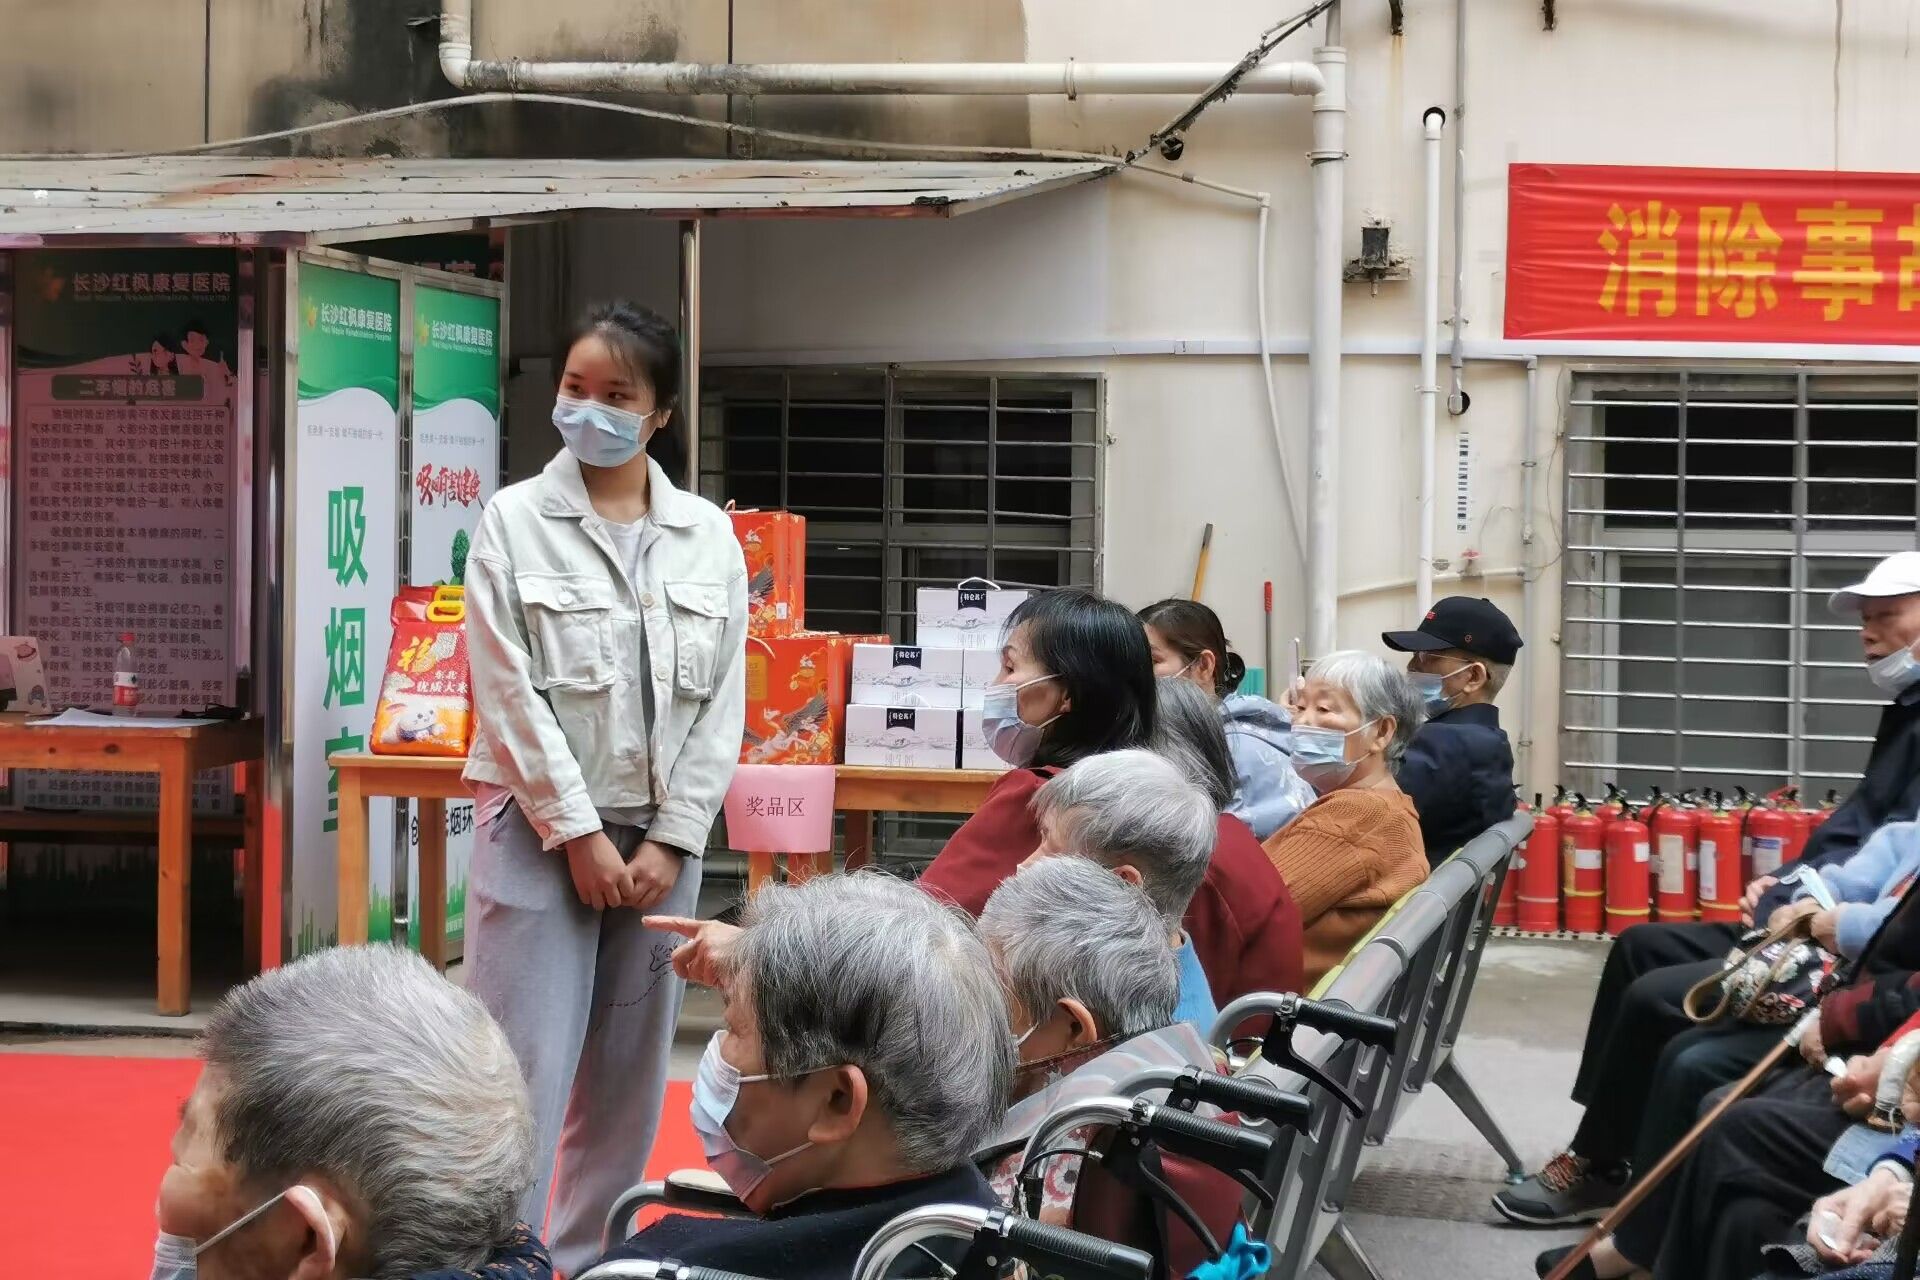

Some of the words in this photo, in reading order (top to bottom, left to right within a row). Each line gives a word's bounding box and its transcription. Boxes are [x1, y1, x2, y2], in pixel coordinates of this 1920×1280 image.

[73, 272, 231, 292] 长沙红枫康复医院
[321, 303, 393, 333] 长沙红枫康复医院
[432, 320, 493, 348] 长沙红枫康复医院
[746, 796, 805, 817] 奖品区
